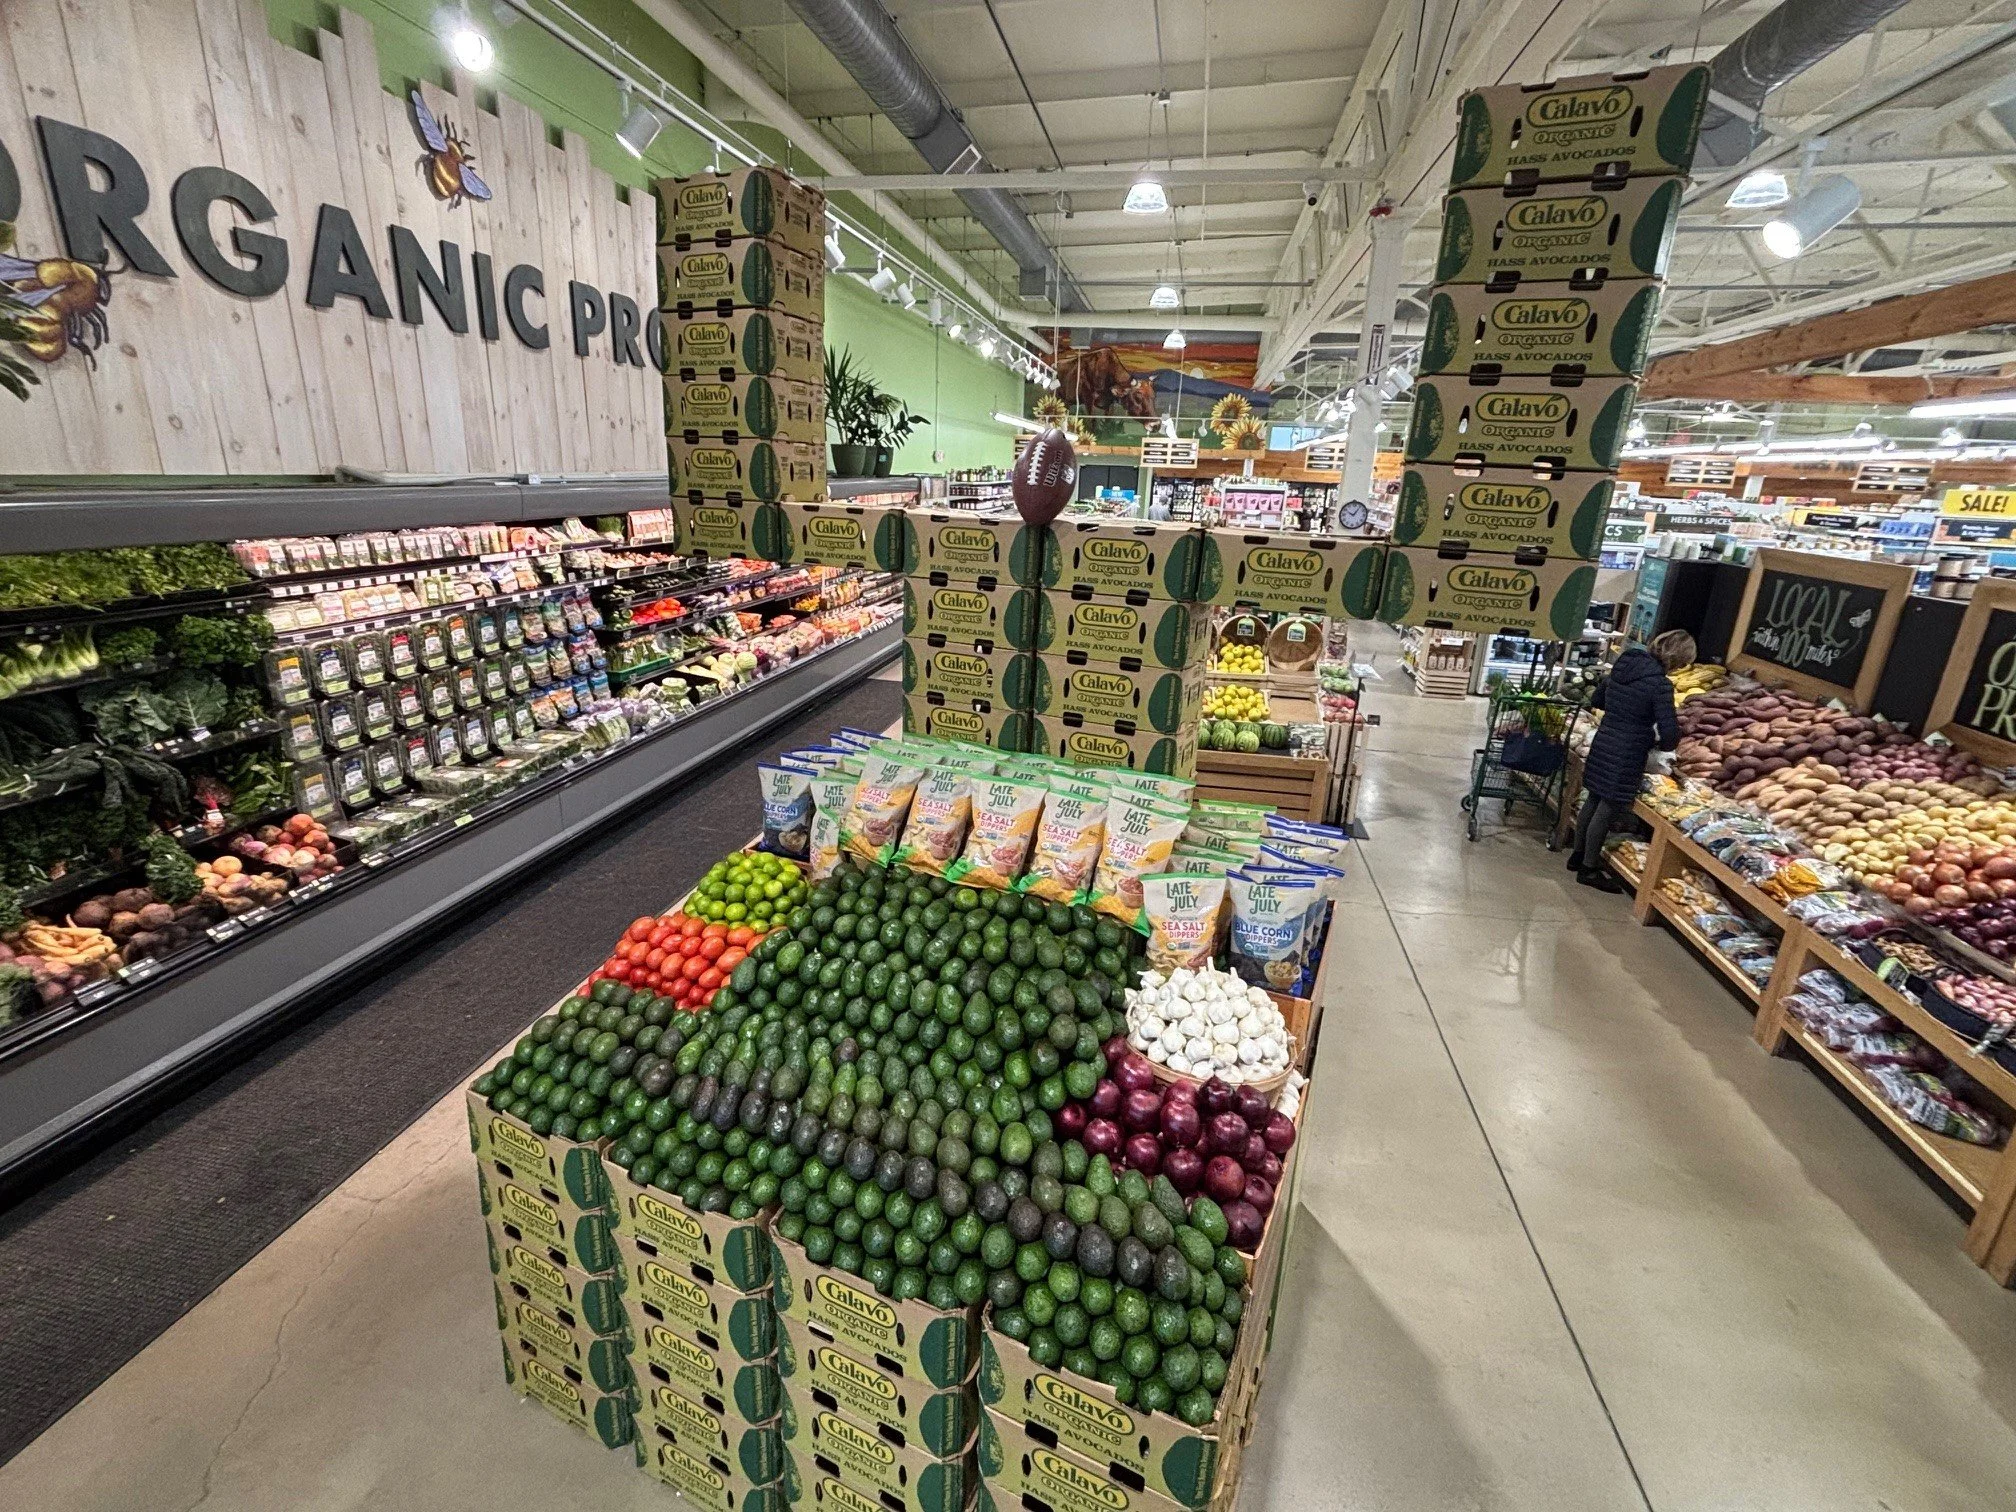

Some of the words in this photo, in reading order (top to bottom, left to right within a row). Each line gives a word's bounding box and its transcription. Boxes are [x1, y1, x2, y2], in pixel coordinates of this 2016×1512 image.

[1540, 88, 1620, 120] Calavo
[1534, 124, 1616, 146] ORGANIC
[1507, 153, 1547, 165] HASS
[1552, 146, 1636, 162] AVOCADOS
[1518, 198, 1596, 226] Calavo
[1512, 233, 1591, 250] ORGANIC
[1488, 258, 1526, 267] HASS
[1530, 254, 1611, 266] AVOCADOS
[1504, 300, 1578, 325] Calavo
[1498, 333, 1574, 348] ORGANIC
[1474, 353, 1510, 361] HASS
[1515, 353, 1593, 361] AVOCADOS
[1488, 395, 1559, 417] Calavo
[1482, 425, 1555, 440] ORGANIC
[1459, 442, 1494, 451] HASS
[1499, 444, 1573, 453] AVOCADOS
[1043, 451, 1063, 487] Wilson
[1471, 487, 1541, 509] Calavo
[1959, 494, 2009, 513] SALE!
[816, 520, 854, 536] Calavo
[1465, 513, 1537, 529] ORGANIC
[1671, 516, 1697, 524] HERBS
[946, 529, 989, 547] Calavo
[1442, 529, 1477, 539] HASS
[1481, 532, 1554, 544] AVOCADOS
[1091, 542, 1140, 560] Calavo
[1257, 550, 1315, 572] Calavo
[1073, 576, 1099, 585] HASS
[1101, 578, 1153, 589] AVOCADOS
[1458, 569, 1527, 591] Calavo
[941, 592, 983, 610] Calavo
[1234, 591, 1263, 599] HASS
[1267, 593, 1327, 604] AVOCADOS
[1453, 594, 1522, 609] ORGANIC
[1082, 607, 1130, 626] Calavo
[1428, 610, 1461, 620] HASS
[1464, 614, 1536, 627] AVOCADOS
[1766, 580, 1852, 647] LOCAL
[1066, 641, 1090, 650] HASS
[1093, 643, 1142, 655] AVOCADOS
[941, 655, 983, 673] Calavo
[1079, 673, 1126, 692] Calavo
[937, 710, 978, 729] Calavo
[1063, 704, 1087, 713] HASS
[1089, 707, 1138, 720] AVOCADOS
[1076, 735, 1122, 755] Calavo
[881, 762, 902, 775] LATE
[932, 771, 954, 782] LATE
[773, 773, 792, 785] LATE
[876, 772, 898, 783] JULY
[1135, 779, 1160, 790] LATE
[772, 784, 792, 796] JULY
[824, 785, 844, 796] LATE
[860, 787, 875, 797] SEA
[874, 790, 891, 800] SALT
[930, 781, 957, 794] JULY
[989, 784, 1014, 795] LATE
[1069, 784, 1093, 795] LATE
[825, 796, 846, 809] JULY
[918, 798, 936, 808] SEA
[936, 802, 954, 812] SALT
[988, 794, 1017, 808] JULY
[1057, 799, 1082, 811] LATE
[1129, 795, 1154, 807] LATE
[781, 807, 797, 815] CORN
[1055, 807, 1085, 819] JULY
[1123, 808, 1151, 823] LATE
[977, 812, 993, 822] SEA
[993, 816, 1015, 827] SALT
[980, 821, 1008, 832] DIPPERS
[1042, 824, 1058, 834] SEA
[1058, 828, 1081, 839] SALT
[1120, 821, 1151, 836] JULY
[1046, 833, 1074, 845] DIPPERS
[1107, 837, 1122, 849] SEA
[1123, 843, 1146, 856] SALT
[1205, 837, 1230, 850] LATE
[1316, 837, 1329, 845] LATE
[1276, 843, 1301, 854] LATE
[1185, 861, 1210, 873] LATE
[1167, 882, 1193, 895] LATE
[1249, 885, 1275, 899] LATE
[1170, 895, 1198, 912] JULY
[1250, 900, 1281, 914] JULY
[1161, 922, 1181, 931] SEA
[1182, 922, 1205, 931] SALT
[1169, 930, 1200, 939] DIPPERS
[1235, 923, 1260, 934] BLUE
[1262, 927, 1291, 938] CORN
[1246, 936, 1277, 945] DIPPERS
[498, 1121, 539, 1152] Calavo
[511, 1189, 552, 1218] Calavo
[645, 1198, 696, 1233] Calavo
[519, 1250, 560, 1280] Calavo
[652, 1268, 702, 1300] Calavo
[826, 1282, 889, 1322] Calavo
[526, 1308, 566, 1338] Calavo
[808, 1310, 839, 1330] HASS
[842, 1327, 907, 1363] AVOCADOS
[659, 1332, 709, 1365] Calavo
[532, 1365, 574, 1396] Calavo
[828, 1355, 888, 1394] Calavo
[665, 1394, 715, 1426] Calavo
[811, 1379, 841, 1398] HASS
[844, 1395, 907, 1432] AVOCADOS
[1046, 1381, 1123, 1430] Calavo
[1044, 1402, 1122, 1446] ORGANIC
[828, 1418, 887, 1458] Calavo
[1022, 1407, 1060, 1431] HASS
[1064, 1428, 1145, 1473] AVOCADOS
[668, 1448, 718, 1482] Calavo
[812, 1442, 841, 1463] HASS
[844, 1461, 905, 1498] AVOCADOS
[1043, 1458, 1118, 1506] Calavo
[1021, 1481, 1057, 1504] HASS
